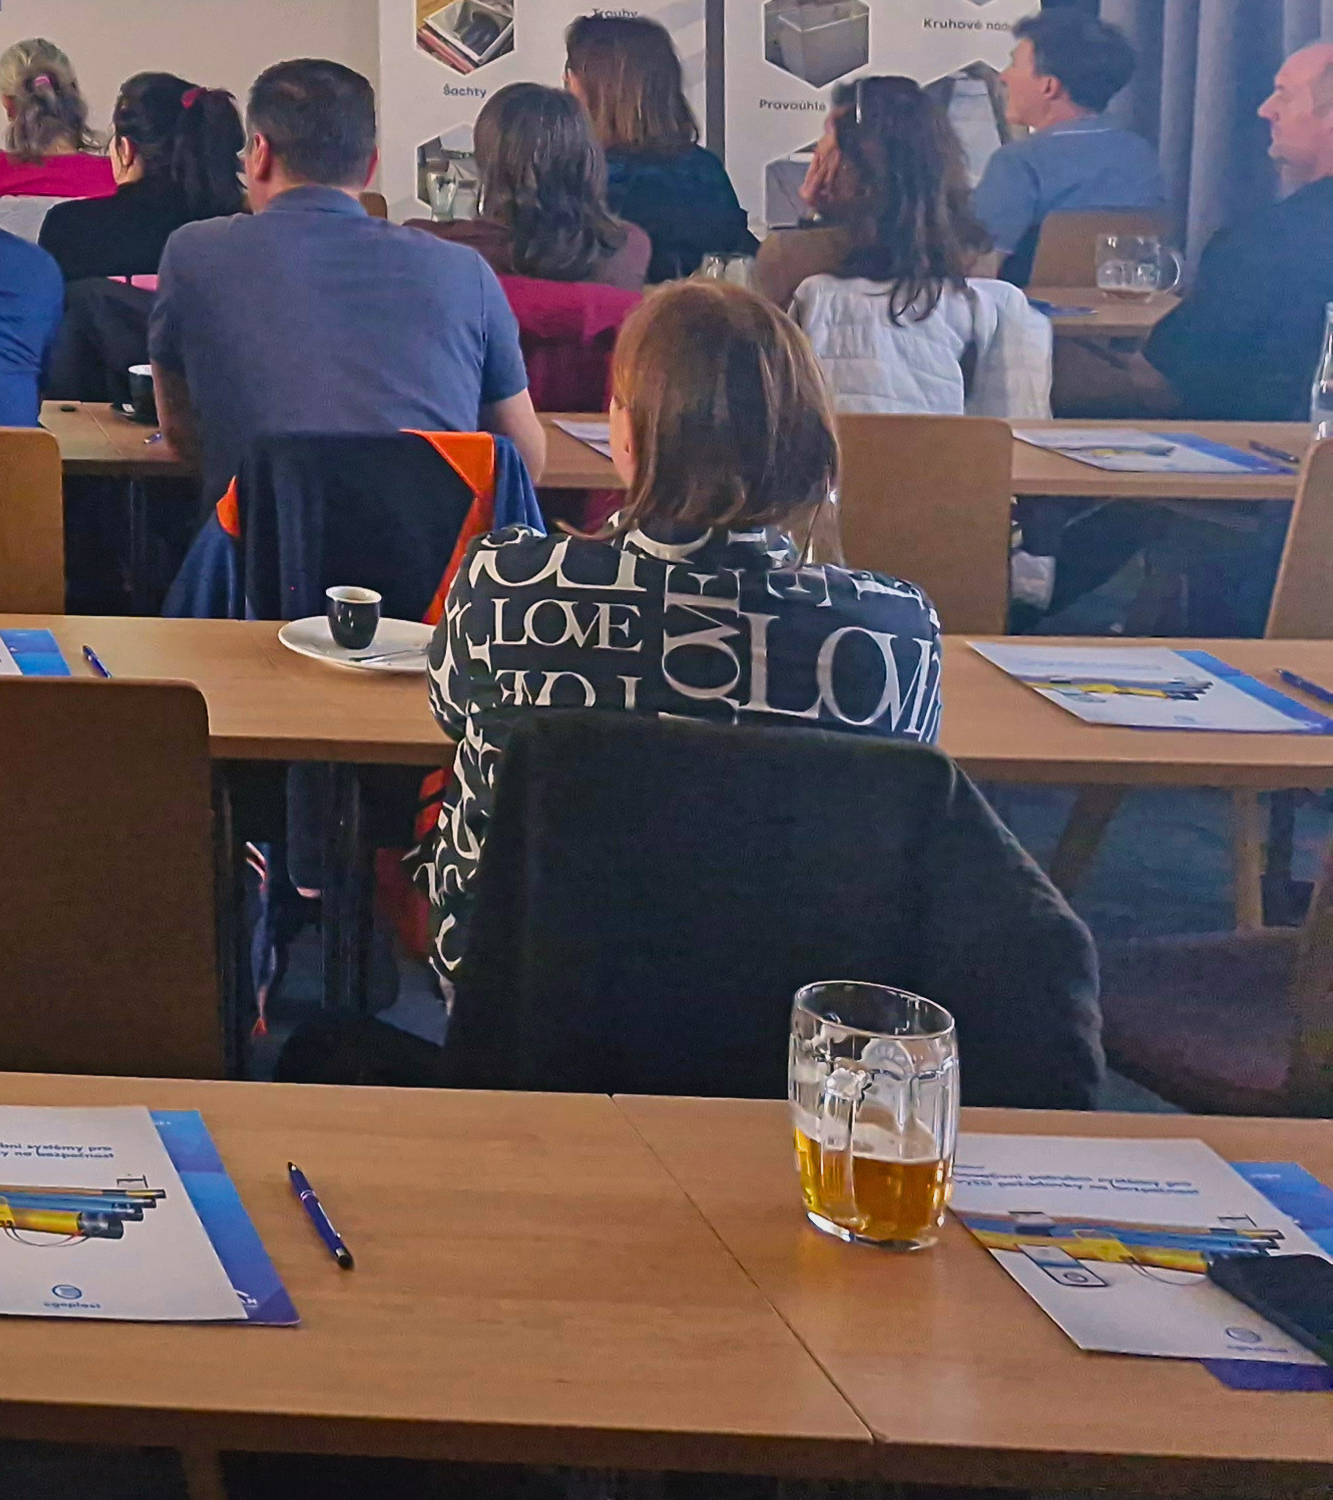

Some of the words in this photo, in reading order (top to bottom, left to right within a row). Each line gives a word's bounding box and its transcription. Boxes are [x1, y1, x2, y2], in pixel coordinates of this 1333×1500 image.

[923, 18, 982, 30] Kruhové
[443, 83, 486, 98] Šachty
[493, 598, 642, 652] LOVE
